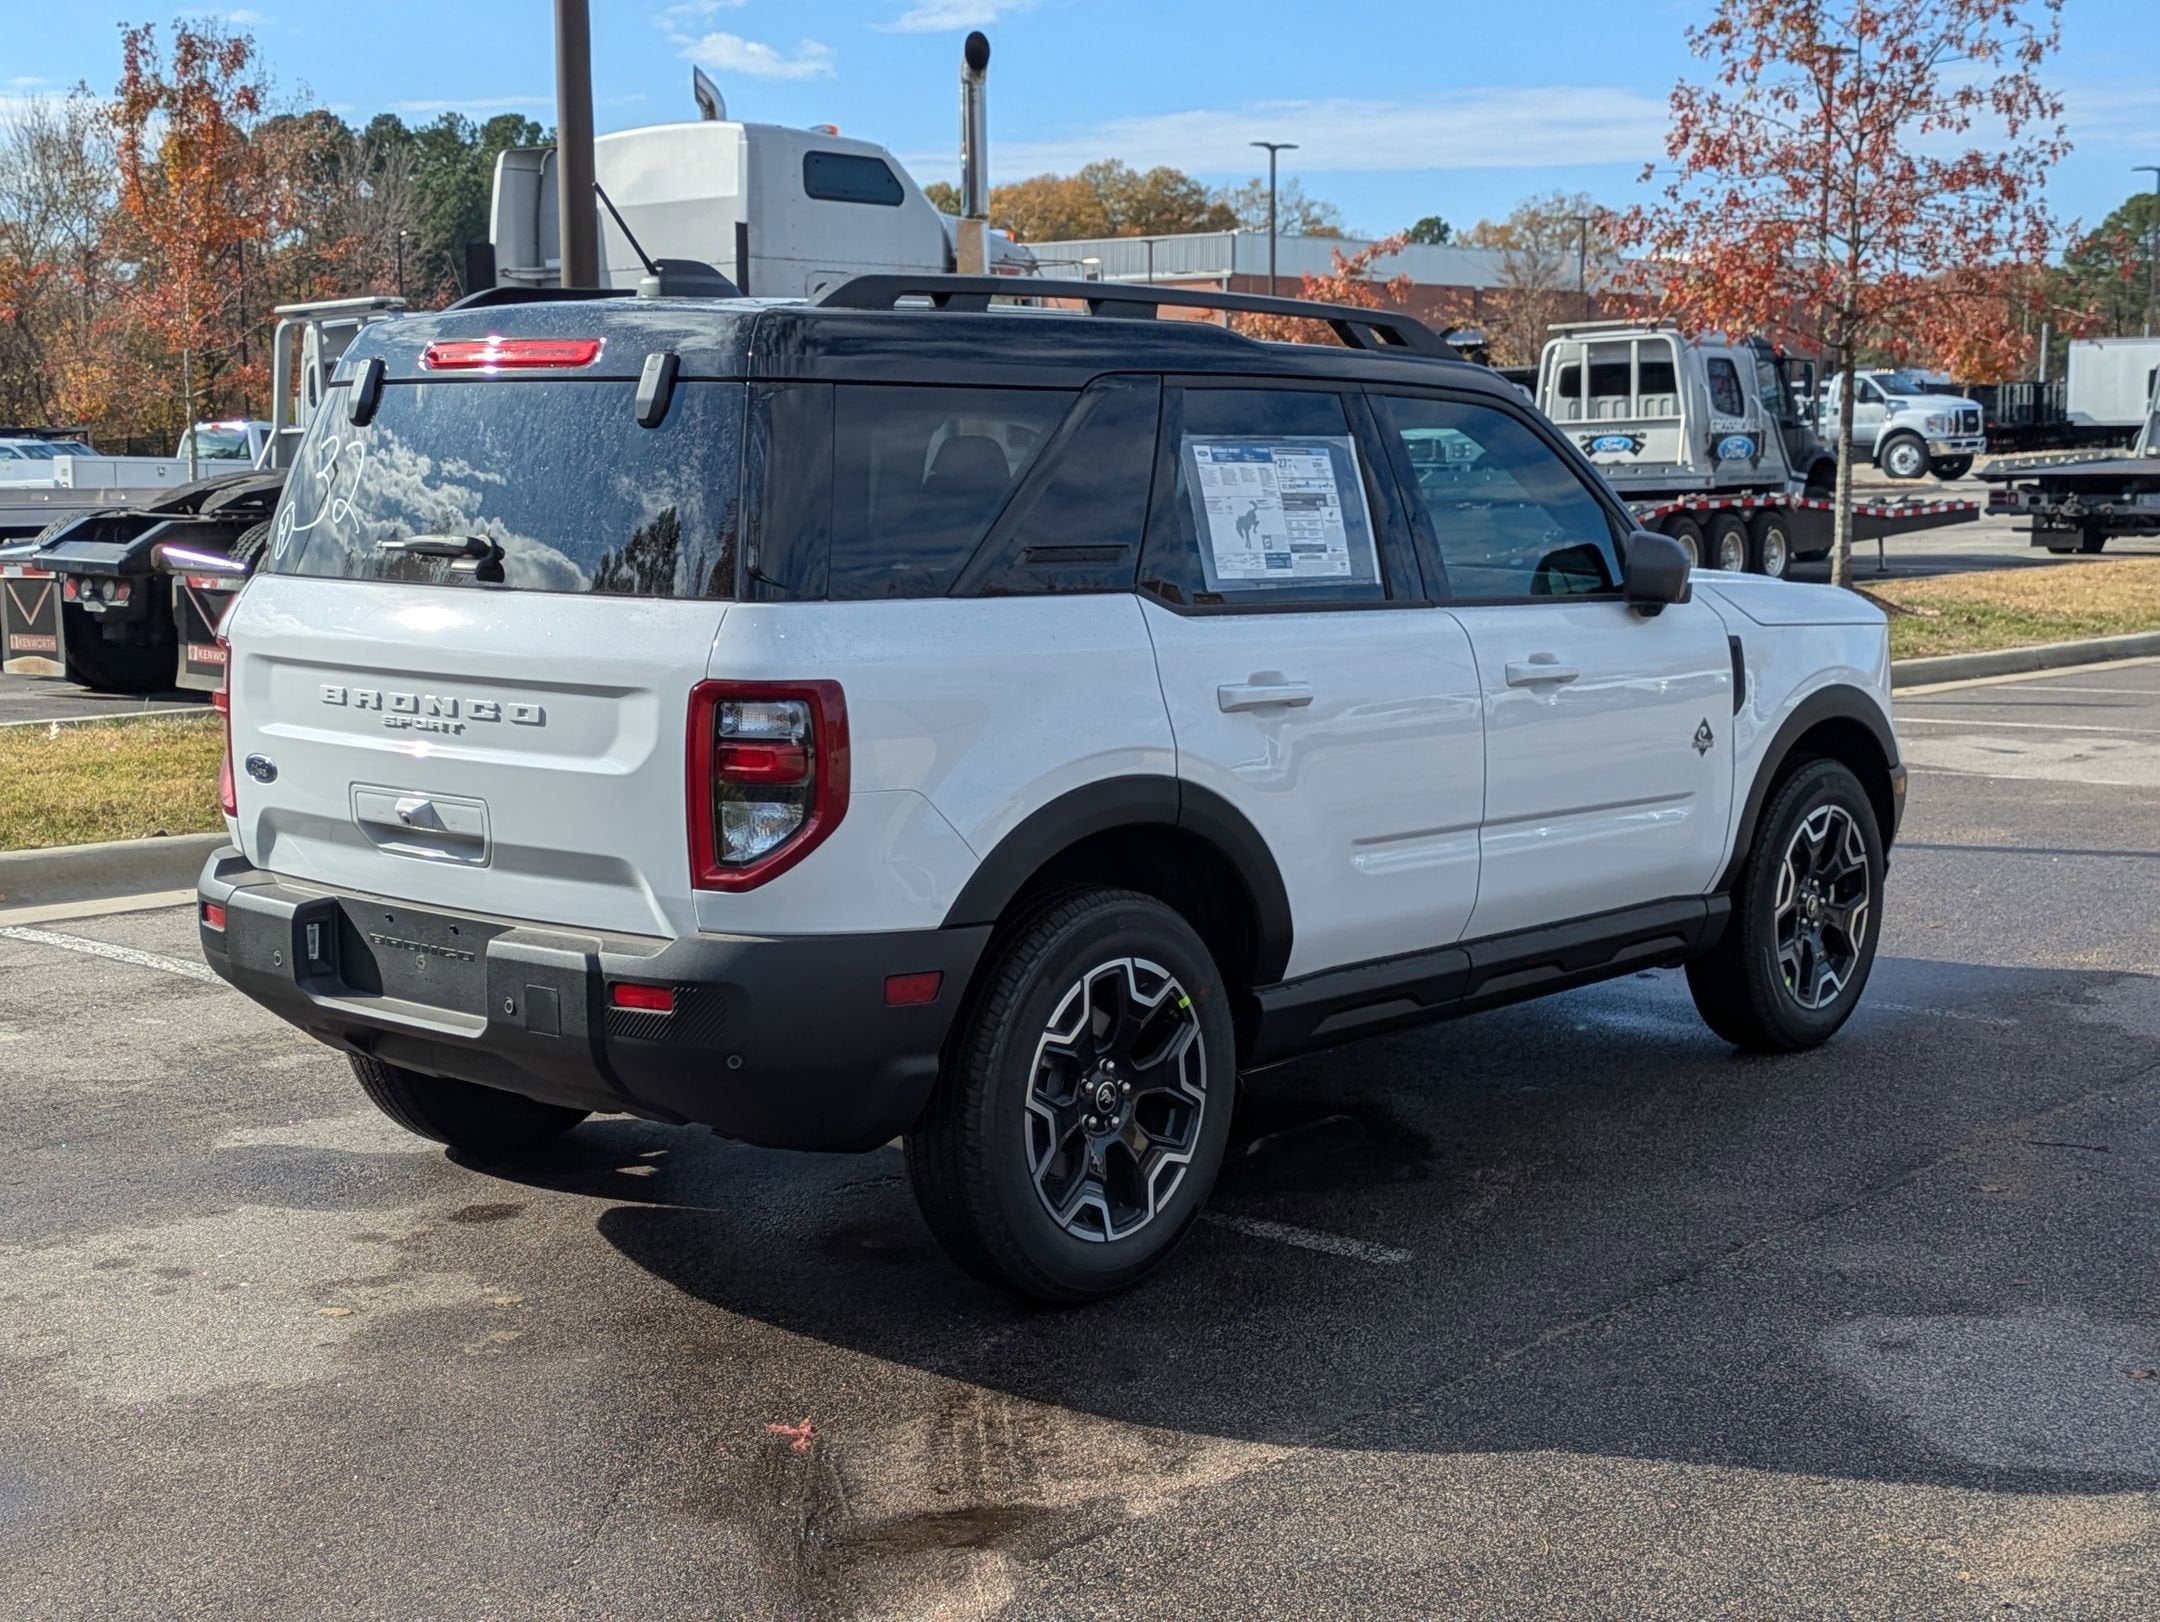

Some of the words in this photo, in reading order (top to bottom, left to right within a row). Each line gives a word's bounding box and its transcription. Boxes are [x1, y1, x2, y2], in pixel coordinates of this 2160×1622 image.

[1722, 437, 1750, 460] Ford
[18, 637, 56, 649] KENWORTH
[198, 648, 226, 662] KENWO
[319, 683, 547, 727] BRONCO
[381, 714, 467, 735] SPORT
[369, 932, 476, 963] BRONCO
